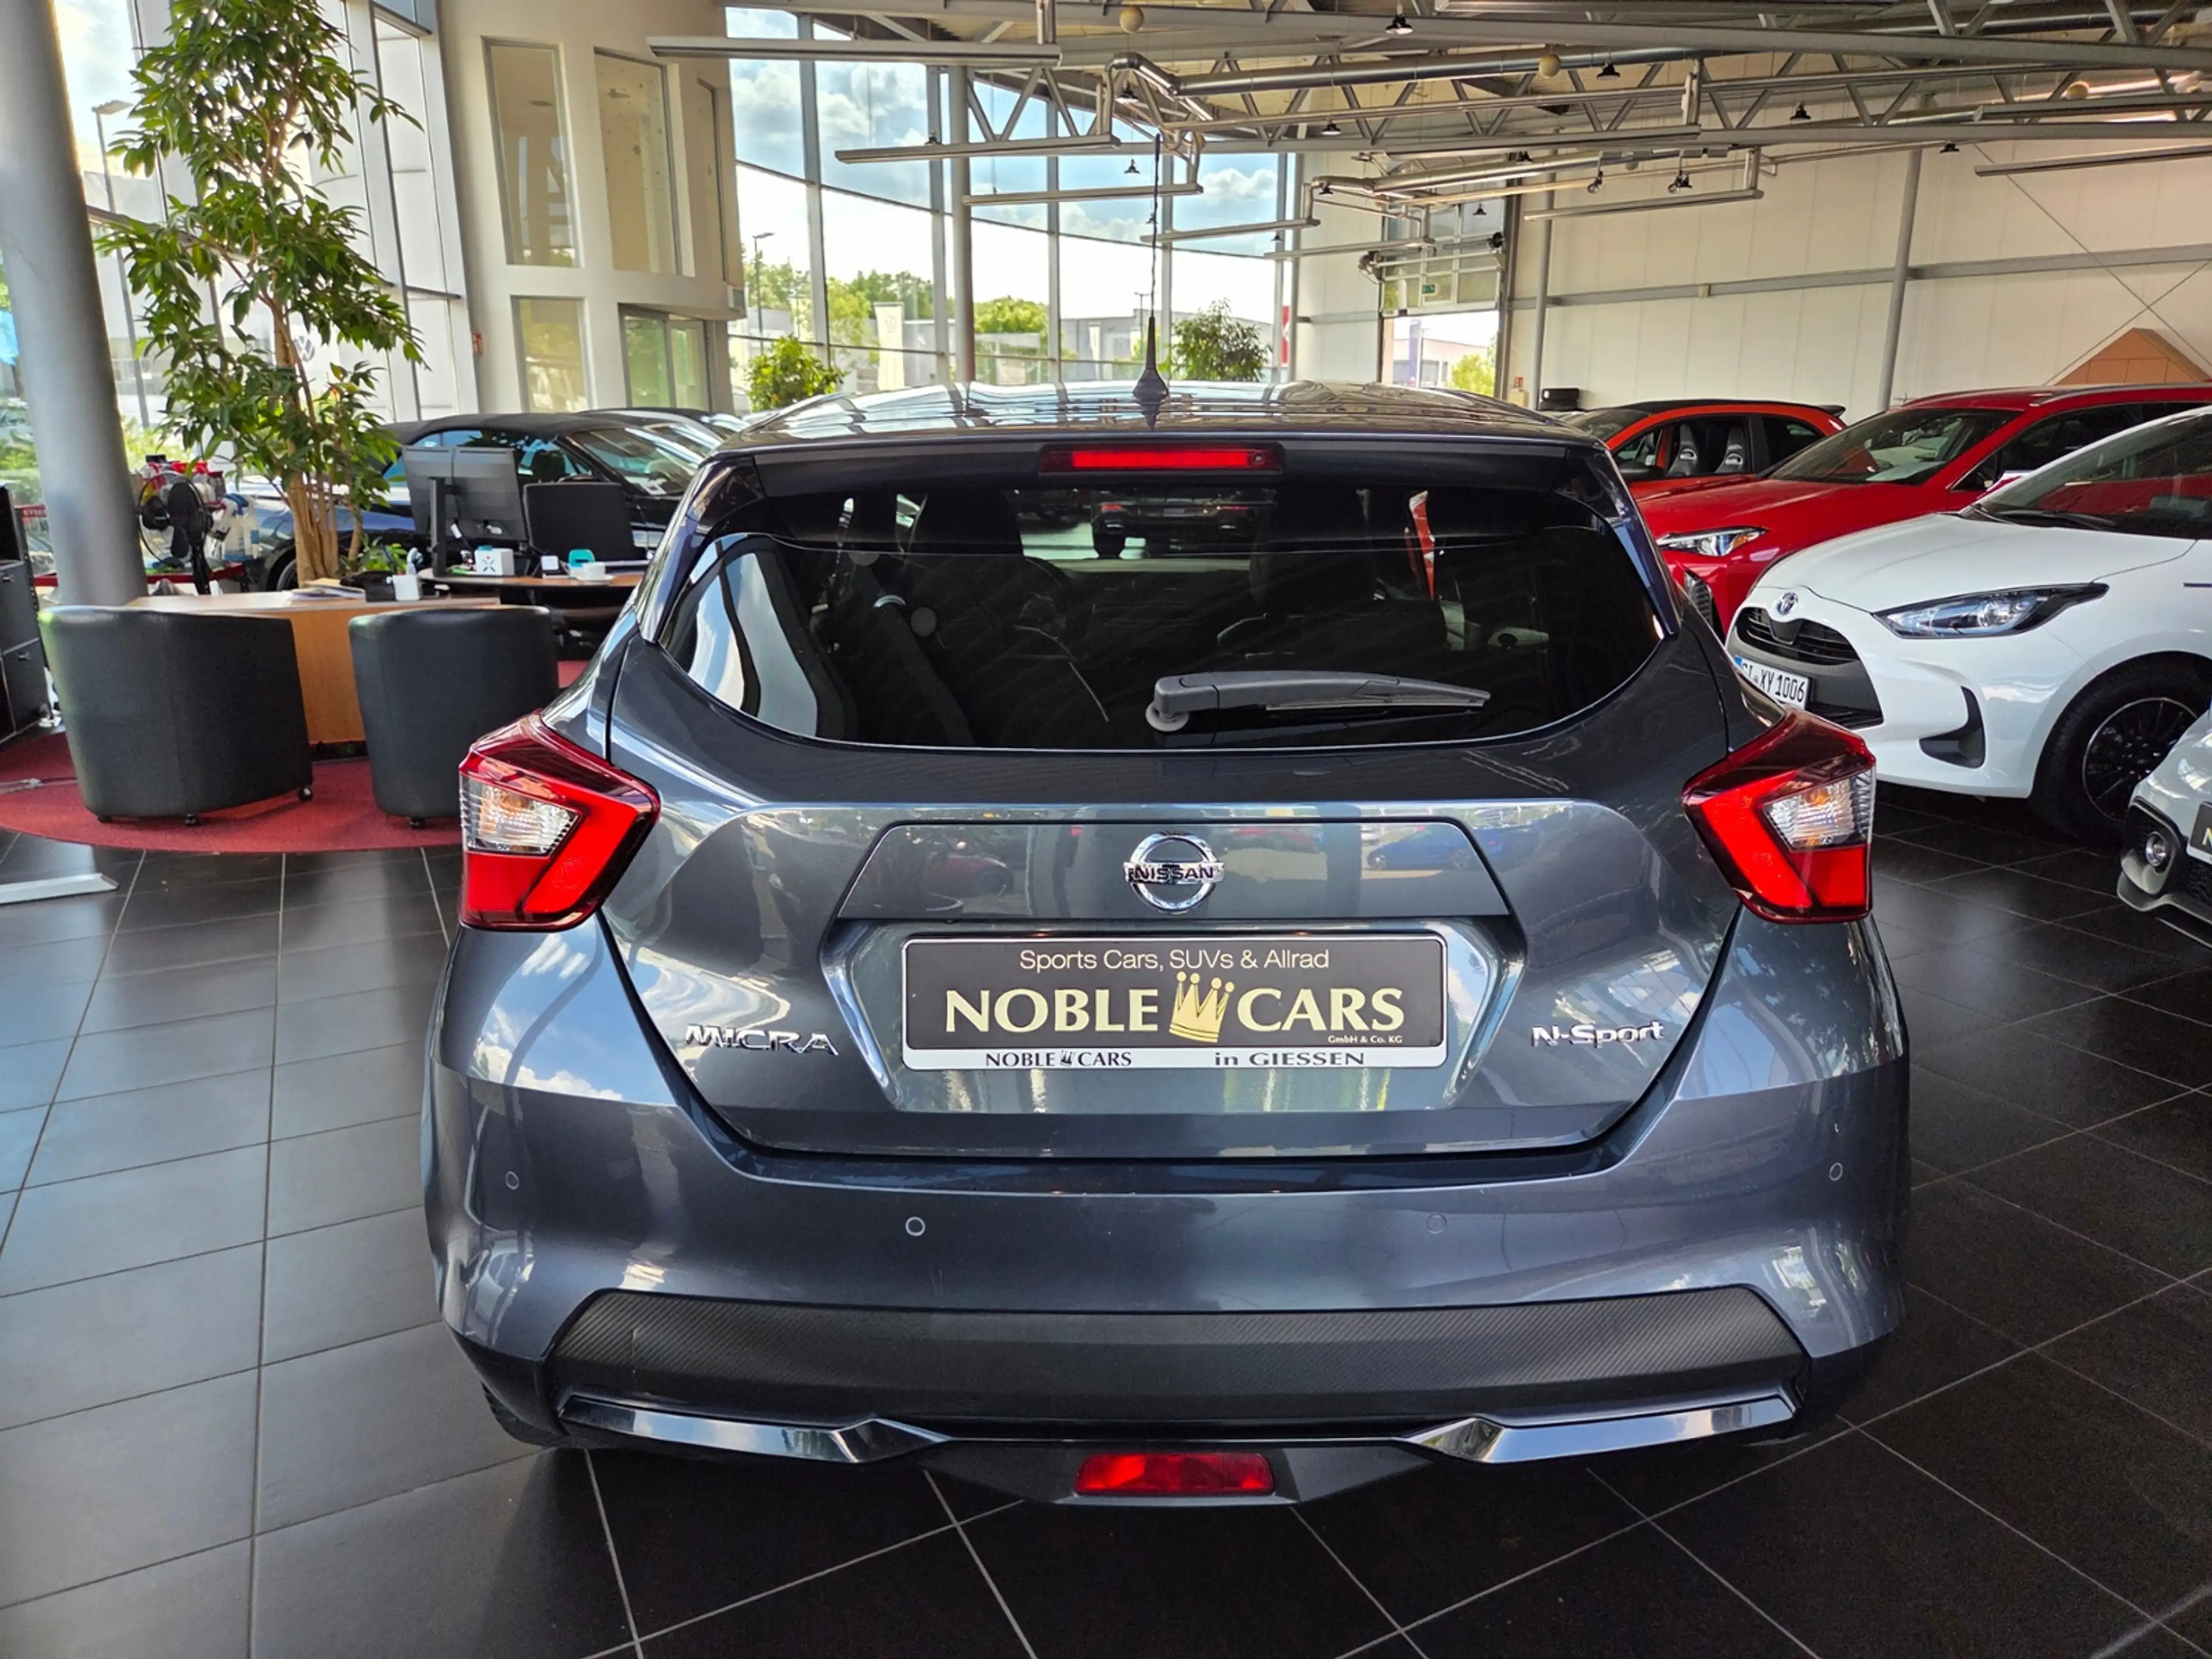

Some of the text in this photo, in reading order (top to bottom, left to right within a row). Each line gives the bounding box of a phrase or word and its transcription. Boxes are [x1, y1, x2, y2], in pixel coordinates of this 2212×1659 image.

[1759, 669, 1775, 693] XY
[1775, 675, 1805, 702] 1006
[1134, 864, 1214, 881] NISSAN
[1020, 949, 1330, 974] Sports Cars, SUVs & Allrad
[945, 987, 1405, 1033] NOBLE CARS
[685, 1024, 839, 1056] MICRA
[1327, 1035, 1403, 1044] GmbH & Co. KG
[1532, 1020, 1664, 1049] N-Sport
[985, 1051, 1365, 1067] NOBLE CARS in GIESSEN
